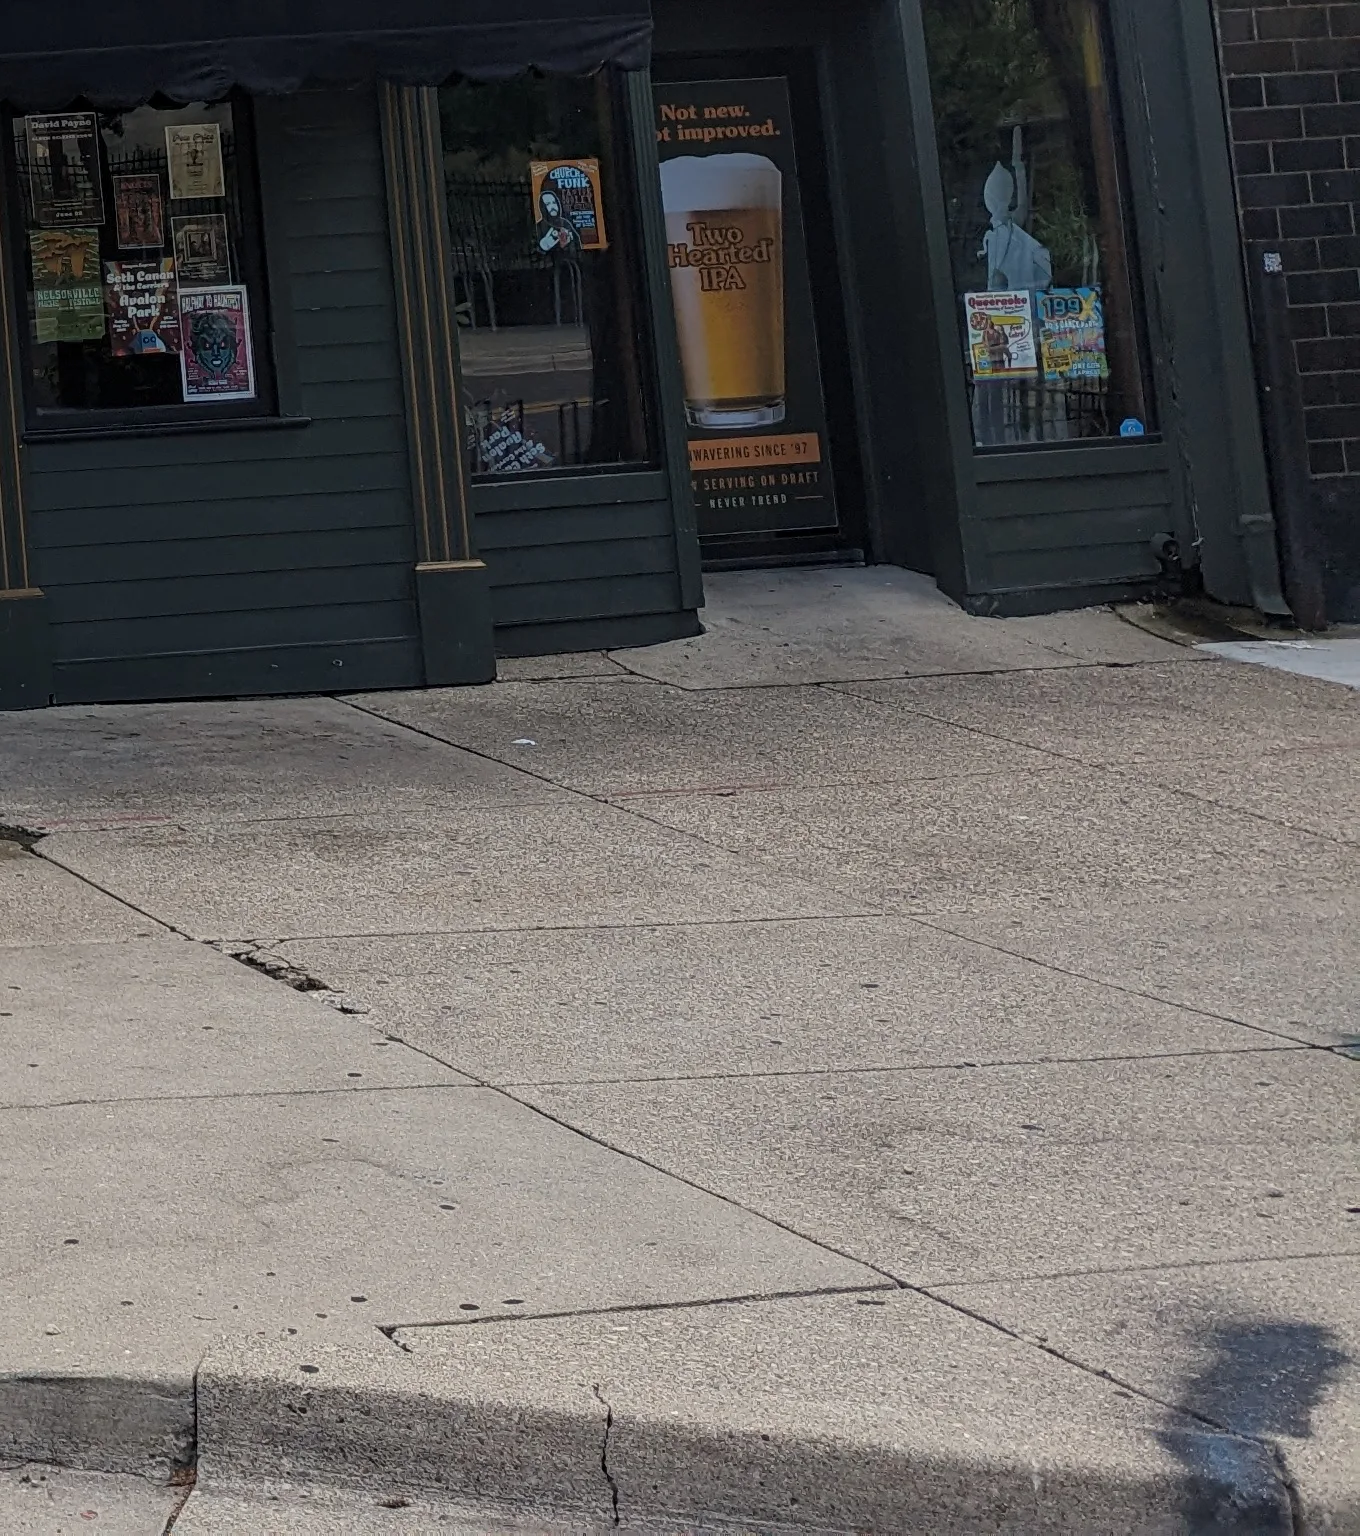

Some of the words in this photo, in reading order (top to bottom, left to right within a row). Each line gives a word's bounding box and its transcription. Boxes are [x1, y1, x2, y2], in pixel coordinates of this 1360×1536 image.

[660, 103, 698, 122] Not
[703, 104, 751, 120] new.
[30, 120, 60, 130] David
[60, 118, 92, 129] Payne
[655, 125, 672, 143] ot
[676, 118, 781, 144] improved.
[557, 176, 591, 189] FUNK
[685, 221, 745, 247] Two
[667, 237, 774, 269] Hearted
[106, 270, 136, 285] Seth
[136, 269, 175, 283] Canan
[698, 265, 747, 292] IPA
[36, 287, 102, 301] NELSONVILLE
[122, 282, 136, 291] the
[119, 292, 167, 308] Avalon
[126, 304, 161, 319] Park
[753, 443, 787, 458] SINCE
[790, 441, 808, 455] '97
[703, 474, 756, 491] SERVING
[759, 473, 777, 487] ON
[780, 470, 820, 485] DRAFT
[708, 495, 746, 509] NEVER
[750, 493, 788, 507] TREND
